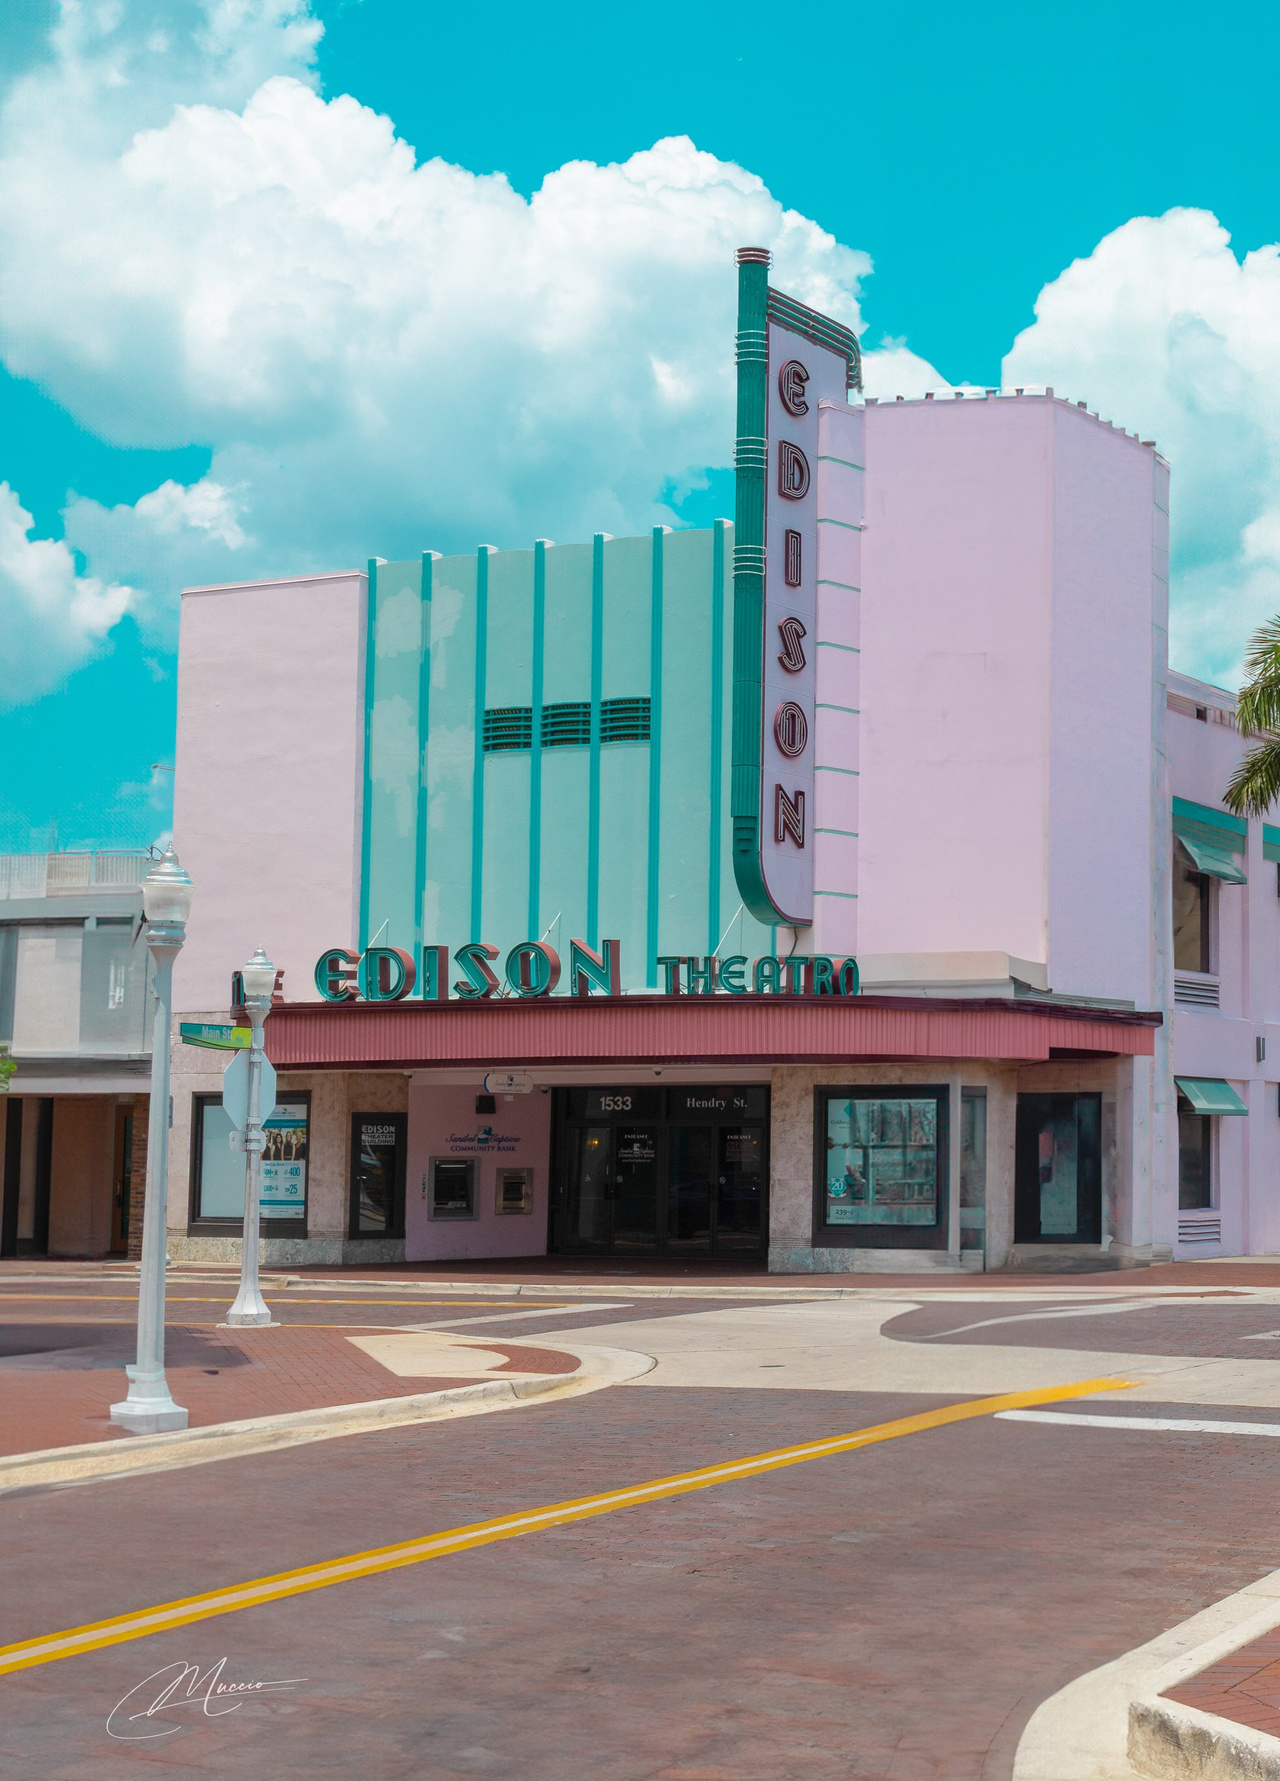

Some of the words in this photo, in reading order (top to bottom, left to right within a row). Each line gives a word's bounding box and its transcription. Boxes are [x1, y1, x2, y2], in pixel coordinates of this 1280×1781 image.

[774, 359, 811, 849] EDISON
[314, 939, 621, 1002] EDISON
[201, 1026, 221, 1039] Main
[600, 1096, 632, 1111] 1533
[687, 1098, 727, 1111] Hendry
[733, 1098, 748, 1108] St.
[362, 1125, 396, 1134] EDISON
[445, 1133, 477, 1143] Sanibel
[489, 1134, 521, 1146] Captiva
[289, 1167, 301, 1177] 400
[290, 1184, 298, 1194] 25
[831, 1182, 843, 1191] 20
